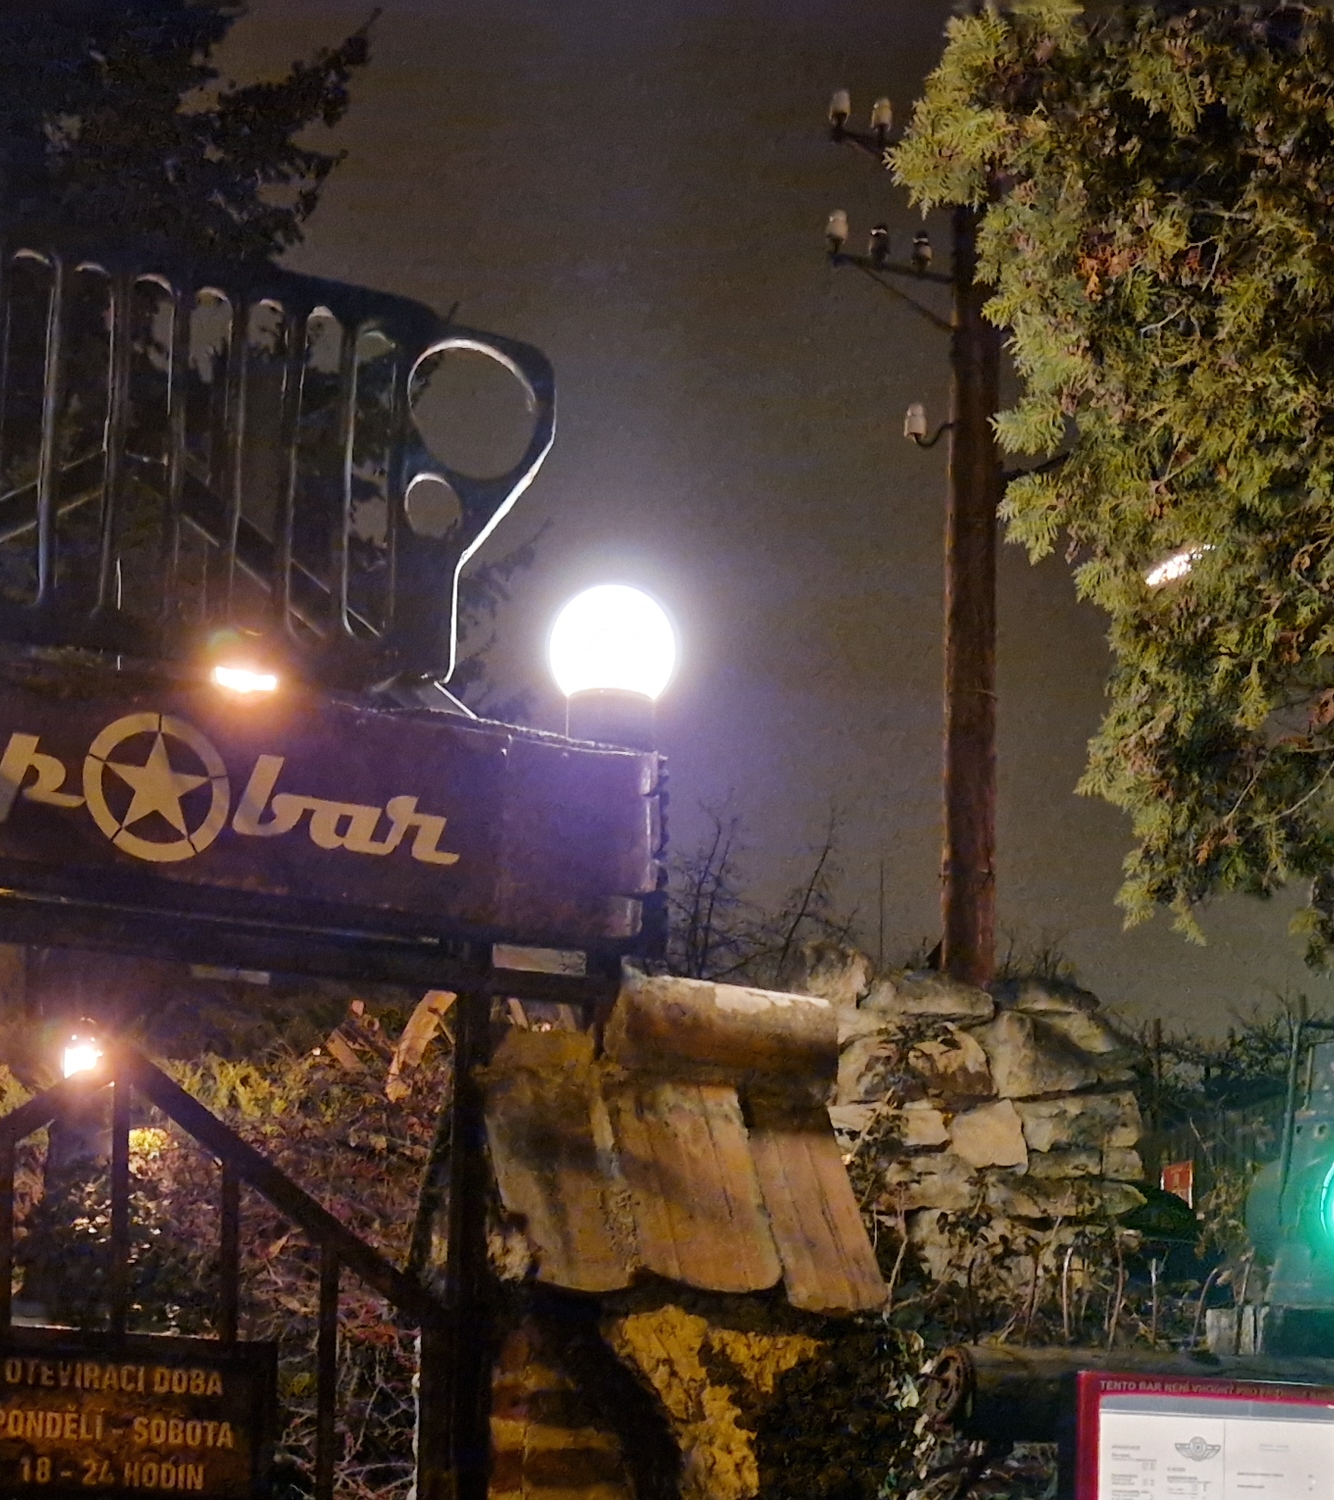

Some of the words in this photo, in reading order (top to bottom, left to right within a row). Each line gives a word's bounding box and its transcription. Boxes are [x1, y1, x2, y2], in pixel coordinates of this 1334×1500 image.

[234, 754, 460, 866] bar
[154, 1366, 224, 1397] DOBA
[1100, 1380, 1137, 1391] TENTO
[132, 1416, 234, 1449] SOBOTA
[20, 1456, 52, 1483] 18
[124, 1461, 205, 1490] HODIN
